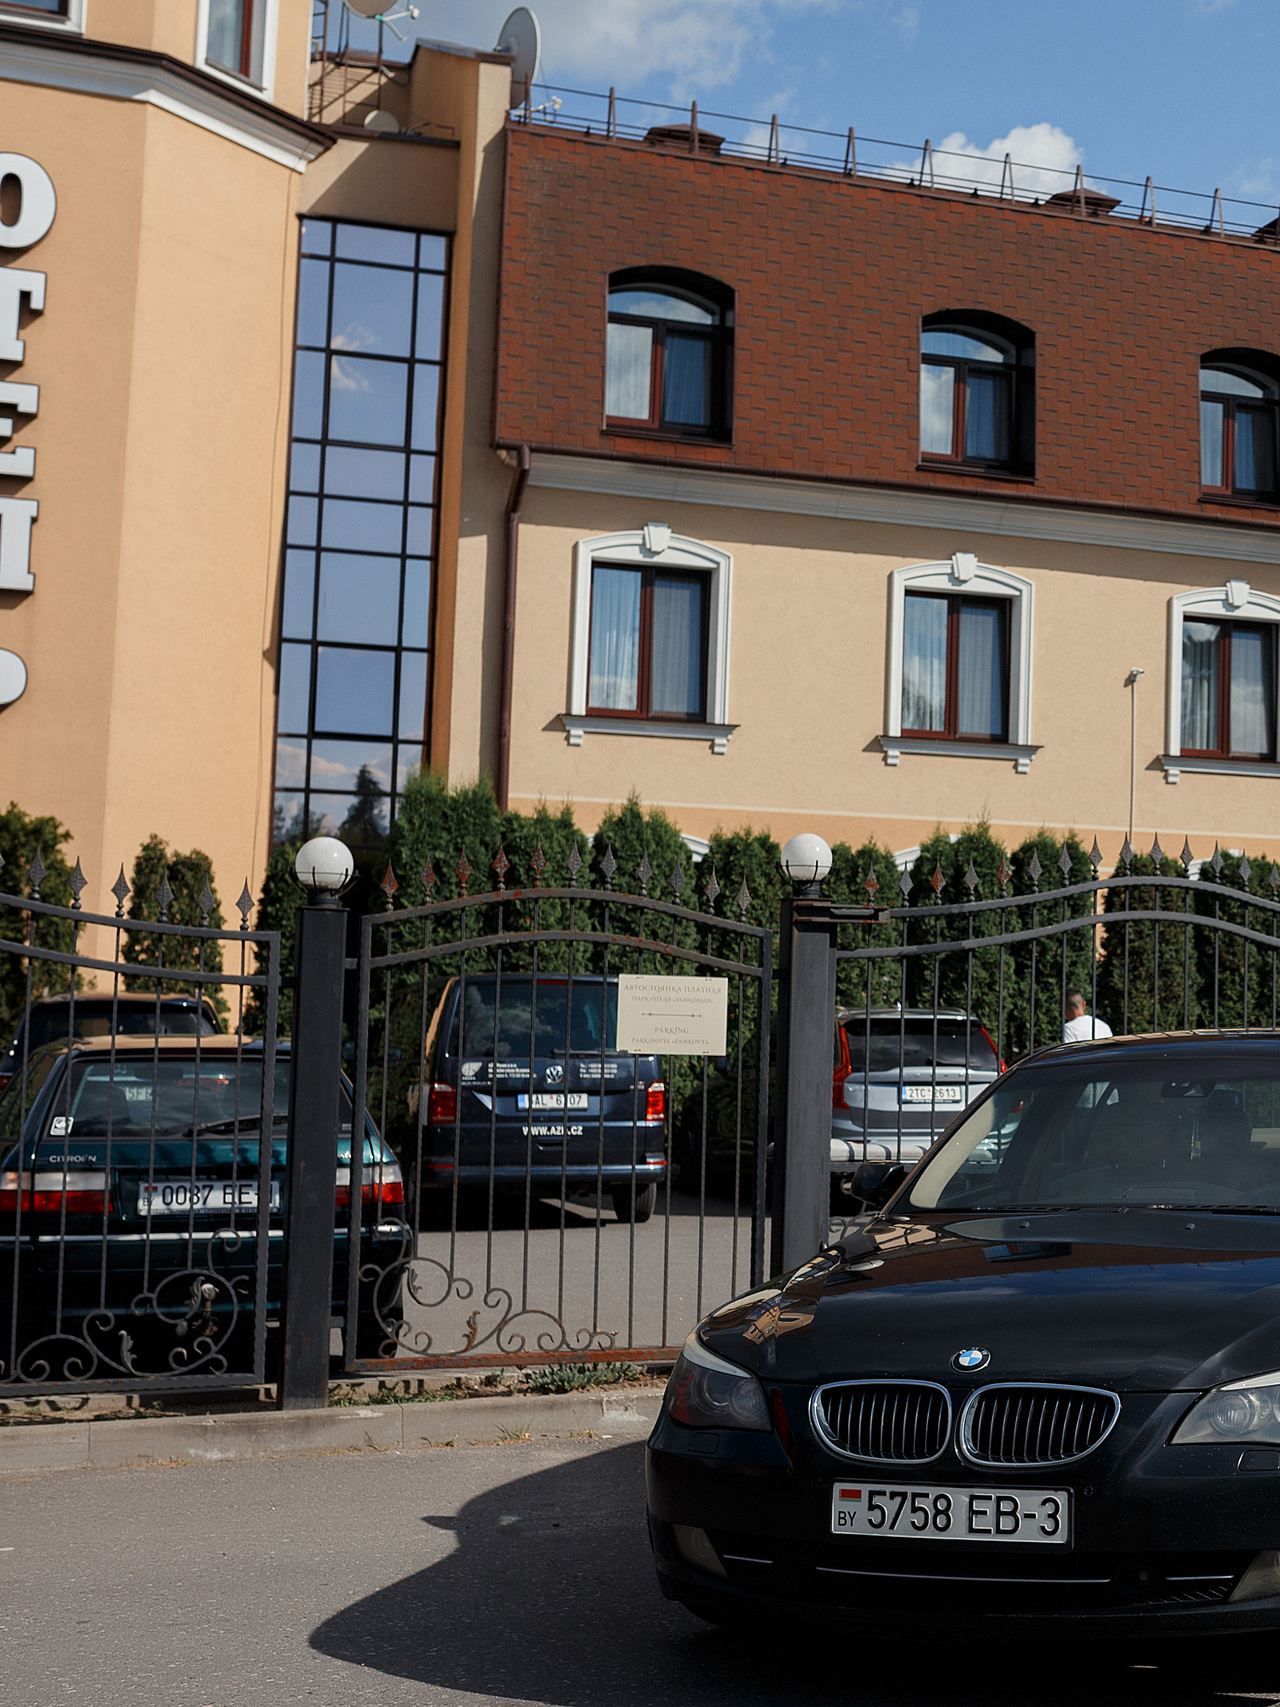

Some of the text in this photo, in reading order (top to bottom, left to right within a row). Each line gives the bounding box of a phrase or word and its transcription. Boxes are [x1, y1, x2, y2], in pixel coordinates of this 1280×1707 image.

[624, 984, 721, 994] АВТОСТОЯНКА ПЛАТНАЯ
[909, 1086, 956, 1098] 2TC 2613
[529, 1094, 547, 1106] AL
[556, 1094, 582, 1106] 607
[162, 1184, 214, 1206] 0087
[837, 1489, 1062, 1536] BY 5758 EB-3
